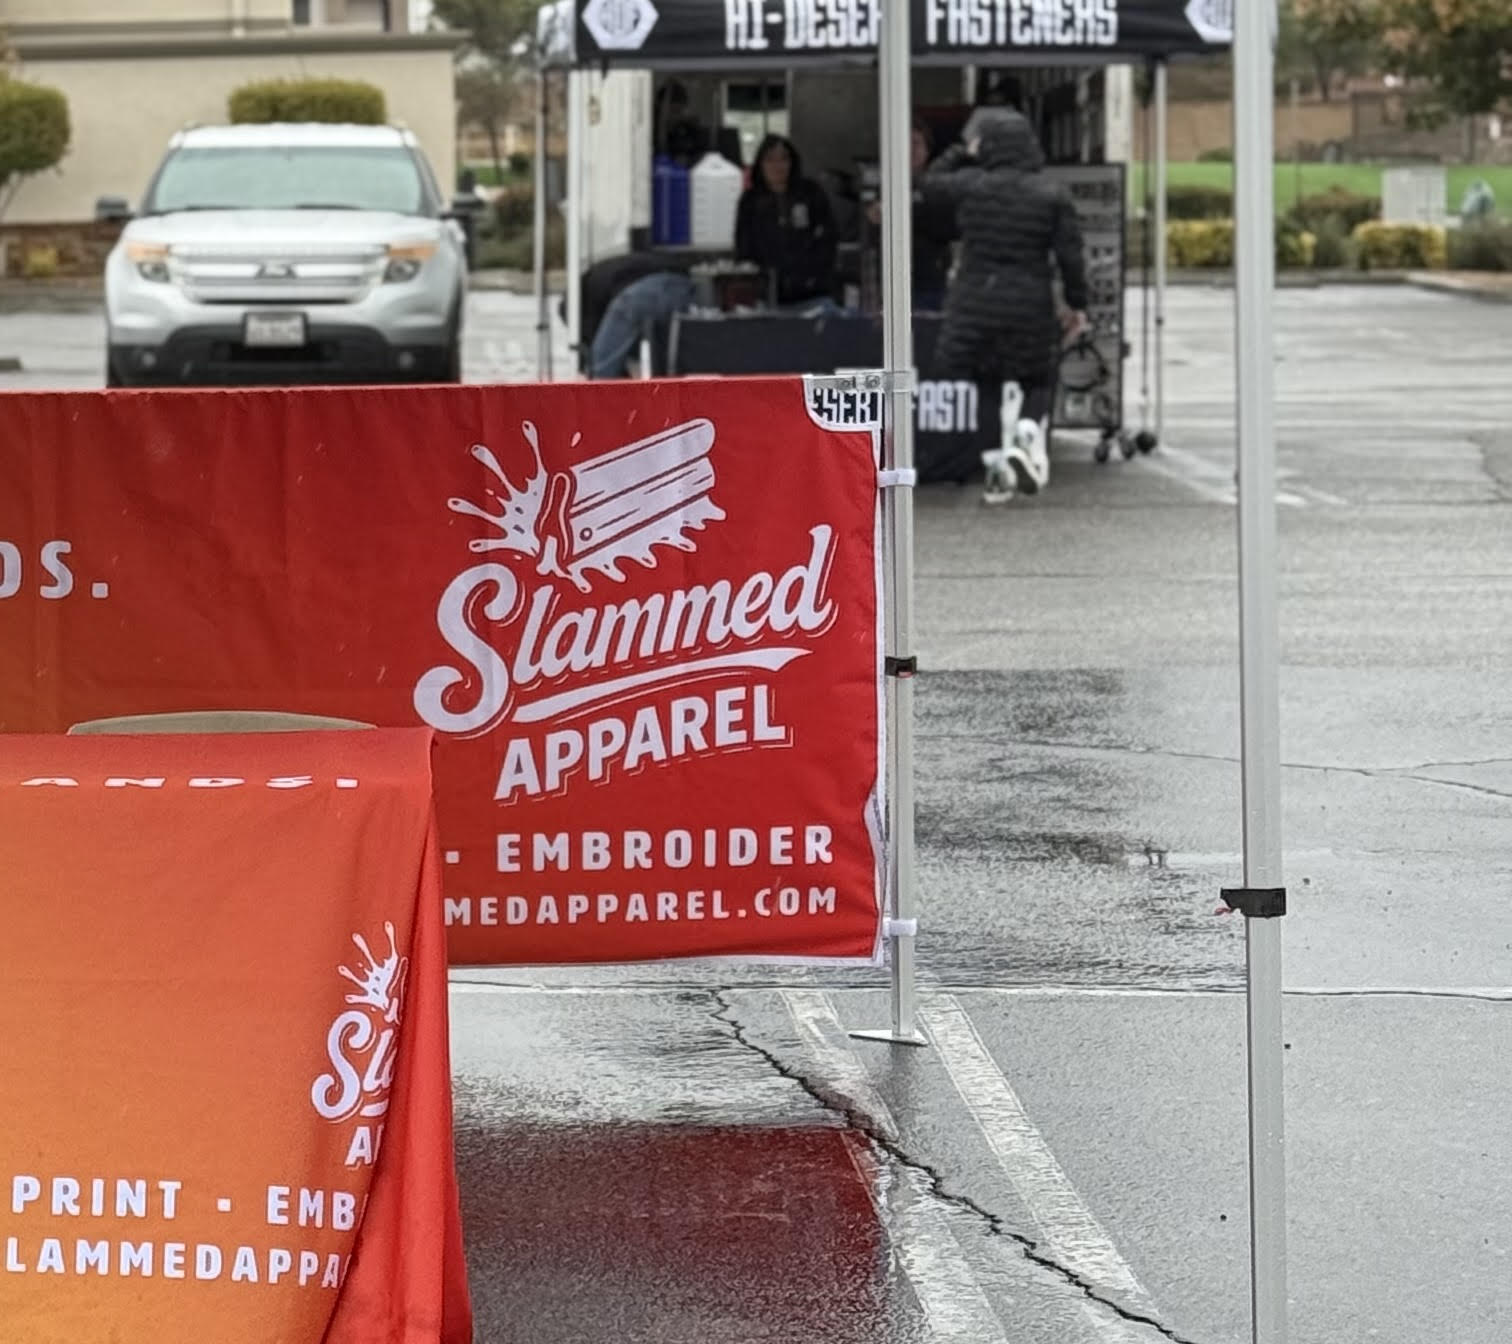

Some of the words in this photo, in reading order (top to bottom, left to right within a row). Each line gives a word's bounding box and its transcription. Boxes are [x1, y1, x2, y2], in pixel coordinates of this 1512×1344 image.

[413, 523, 838, 739] Slammed
[493, 684, 793, 805] APPAREL
[496, 825, 834, 872] EMBROIDER
[444, 886, 837, 926] MEDAPPAREL.COM
[12, 1175, 182, 1219] PRINT
[266, 1185, 367, 1231] EMB
